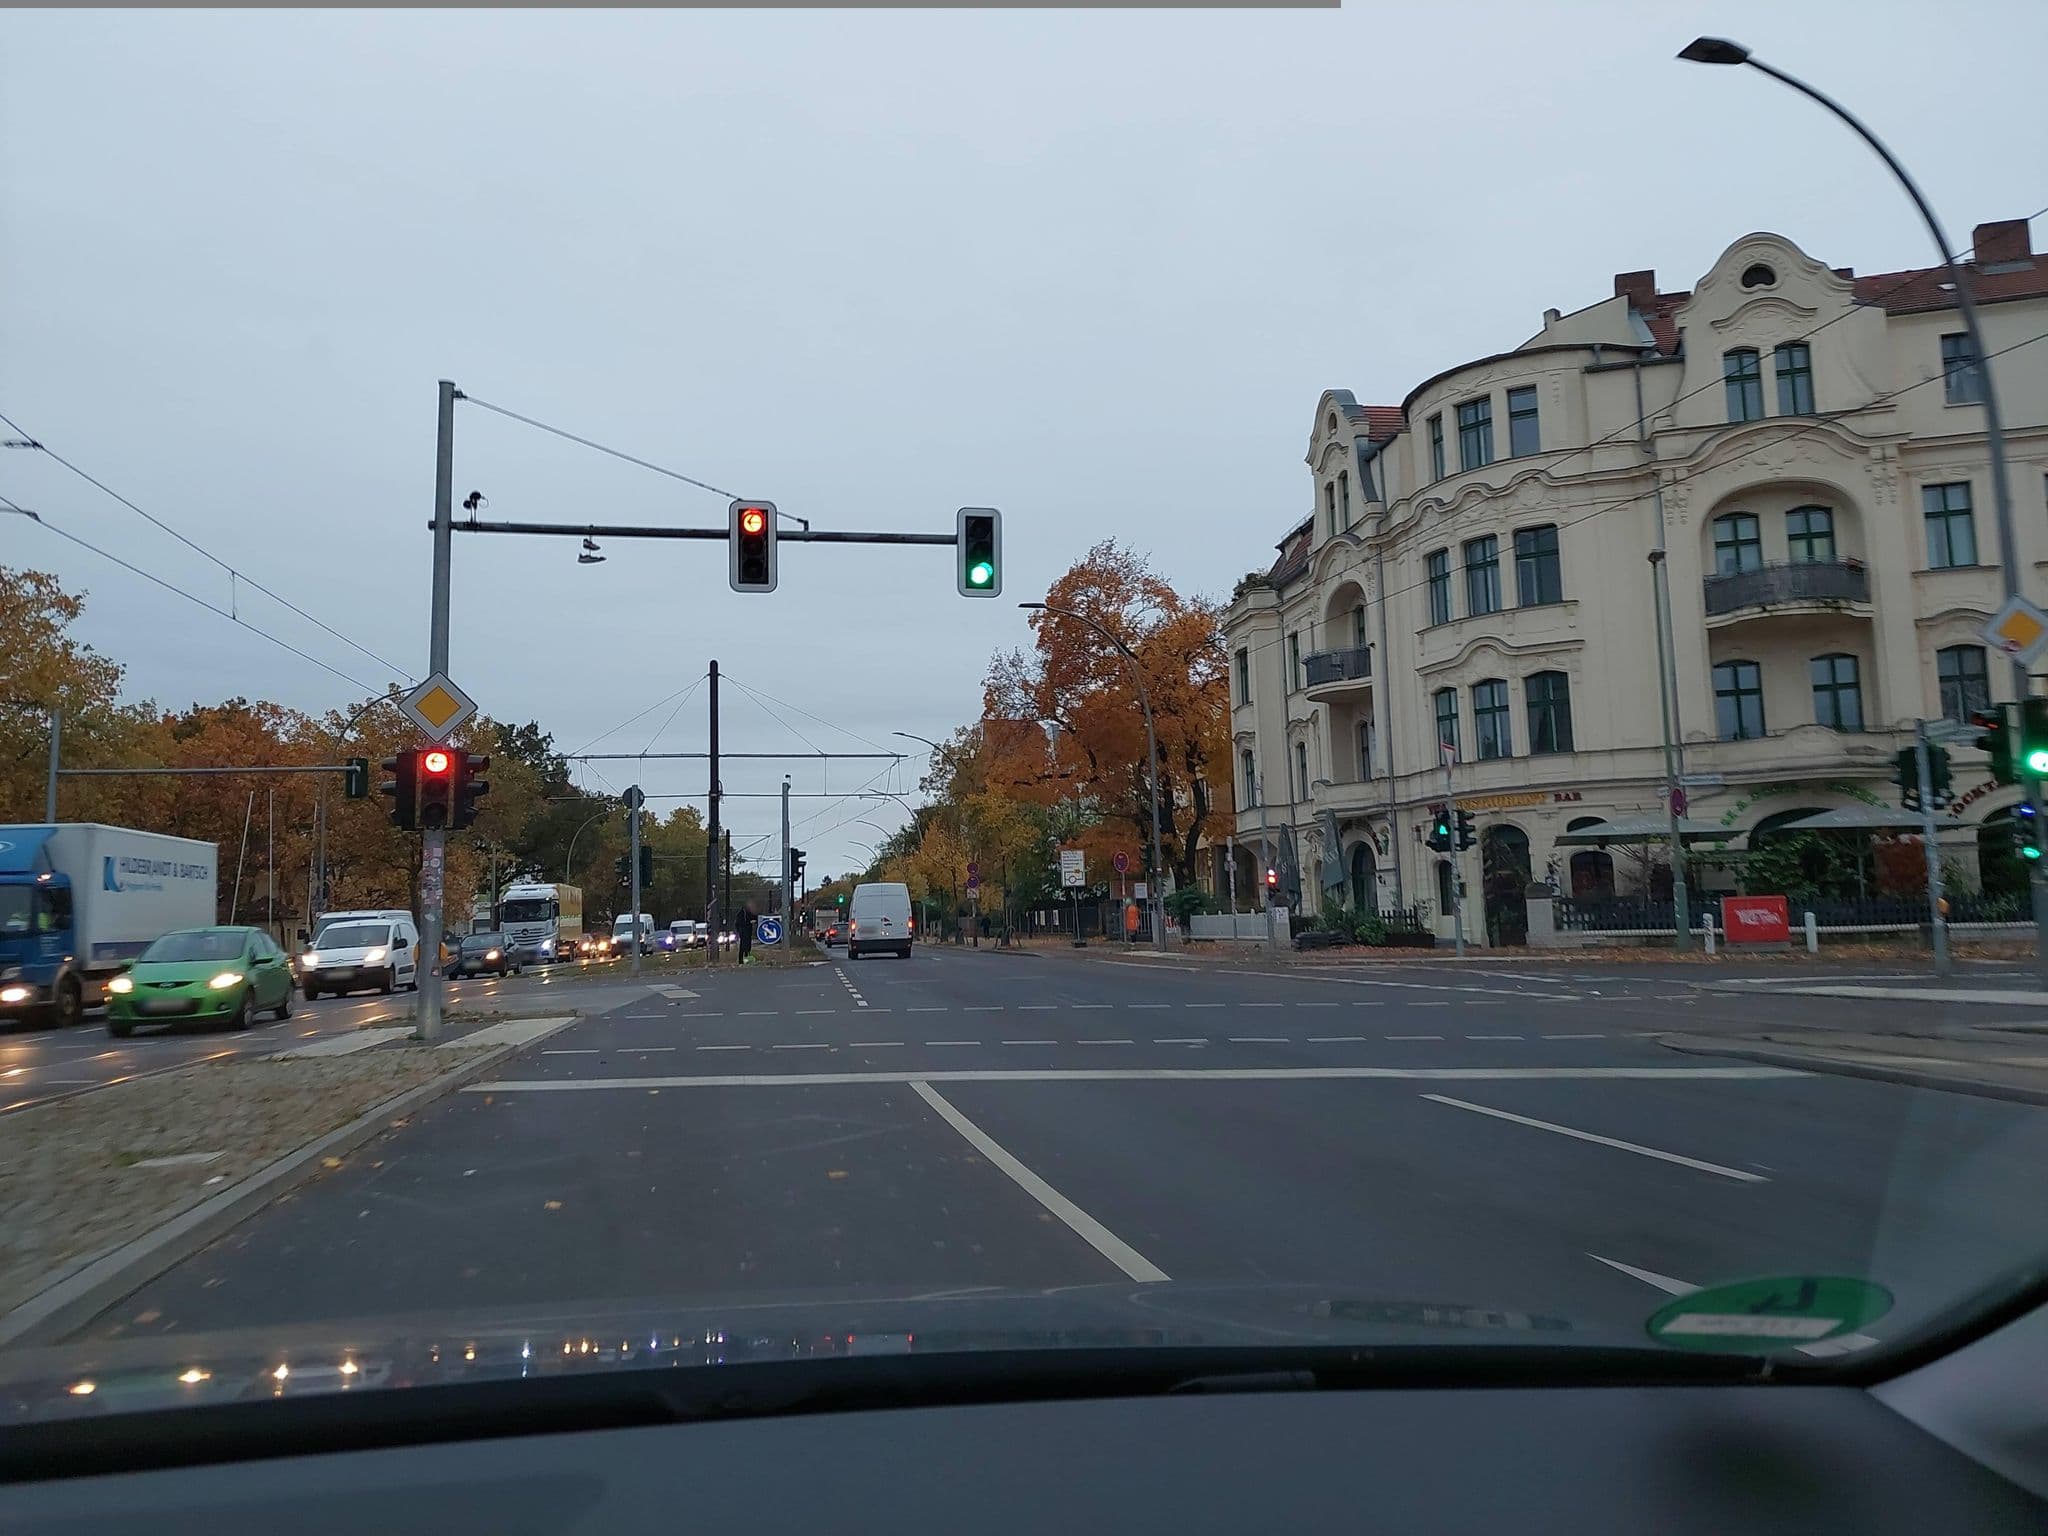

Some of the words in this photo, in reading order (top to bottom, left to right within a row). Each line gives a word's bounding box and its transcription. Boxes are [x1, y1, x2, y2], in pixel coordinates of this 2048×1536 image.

[1554, 791, 1582, 803] BAR
[120, 856, 172, 876] HILDEBRANDT
[180, 863, 209, 880] BARTSCH
